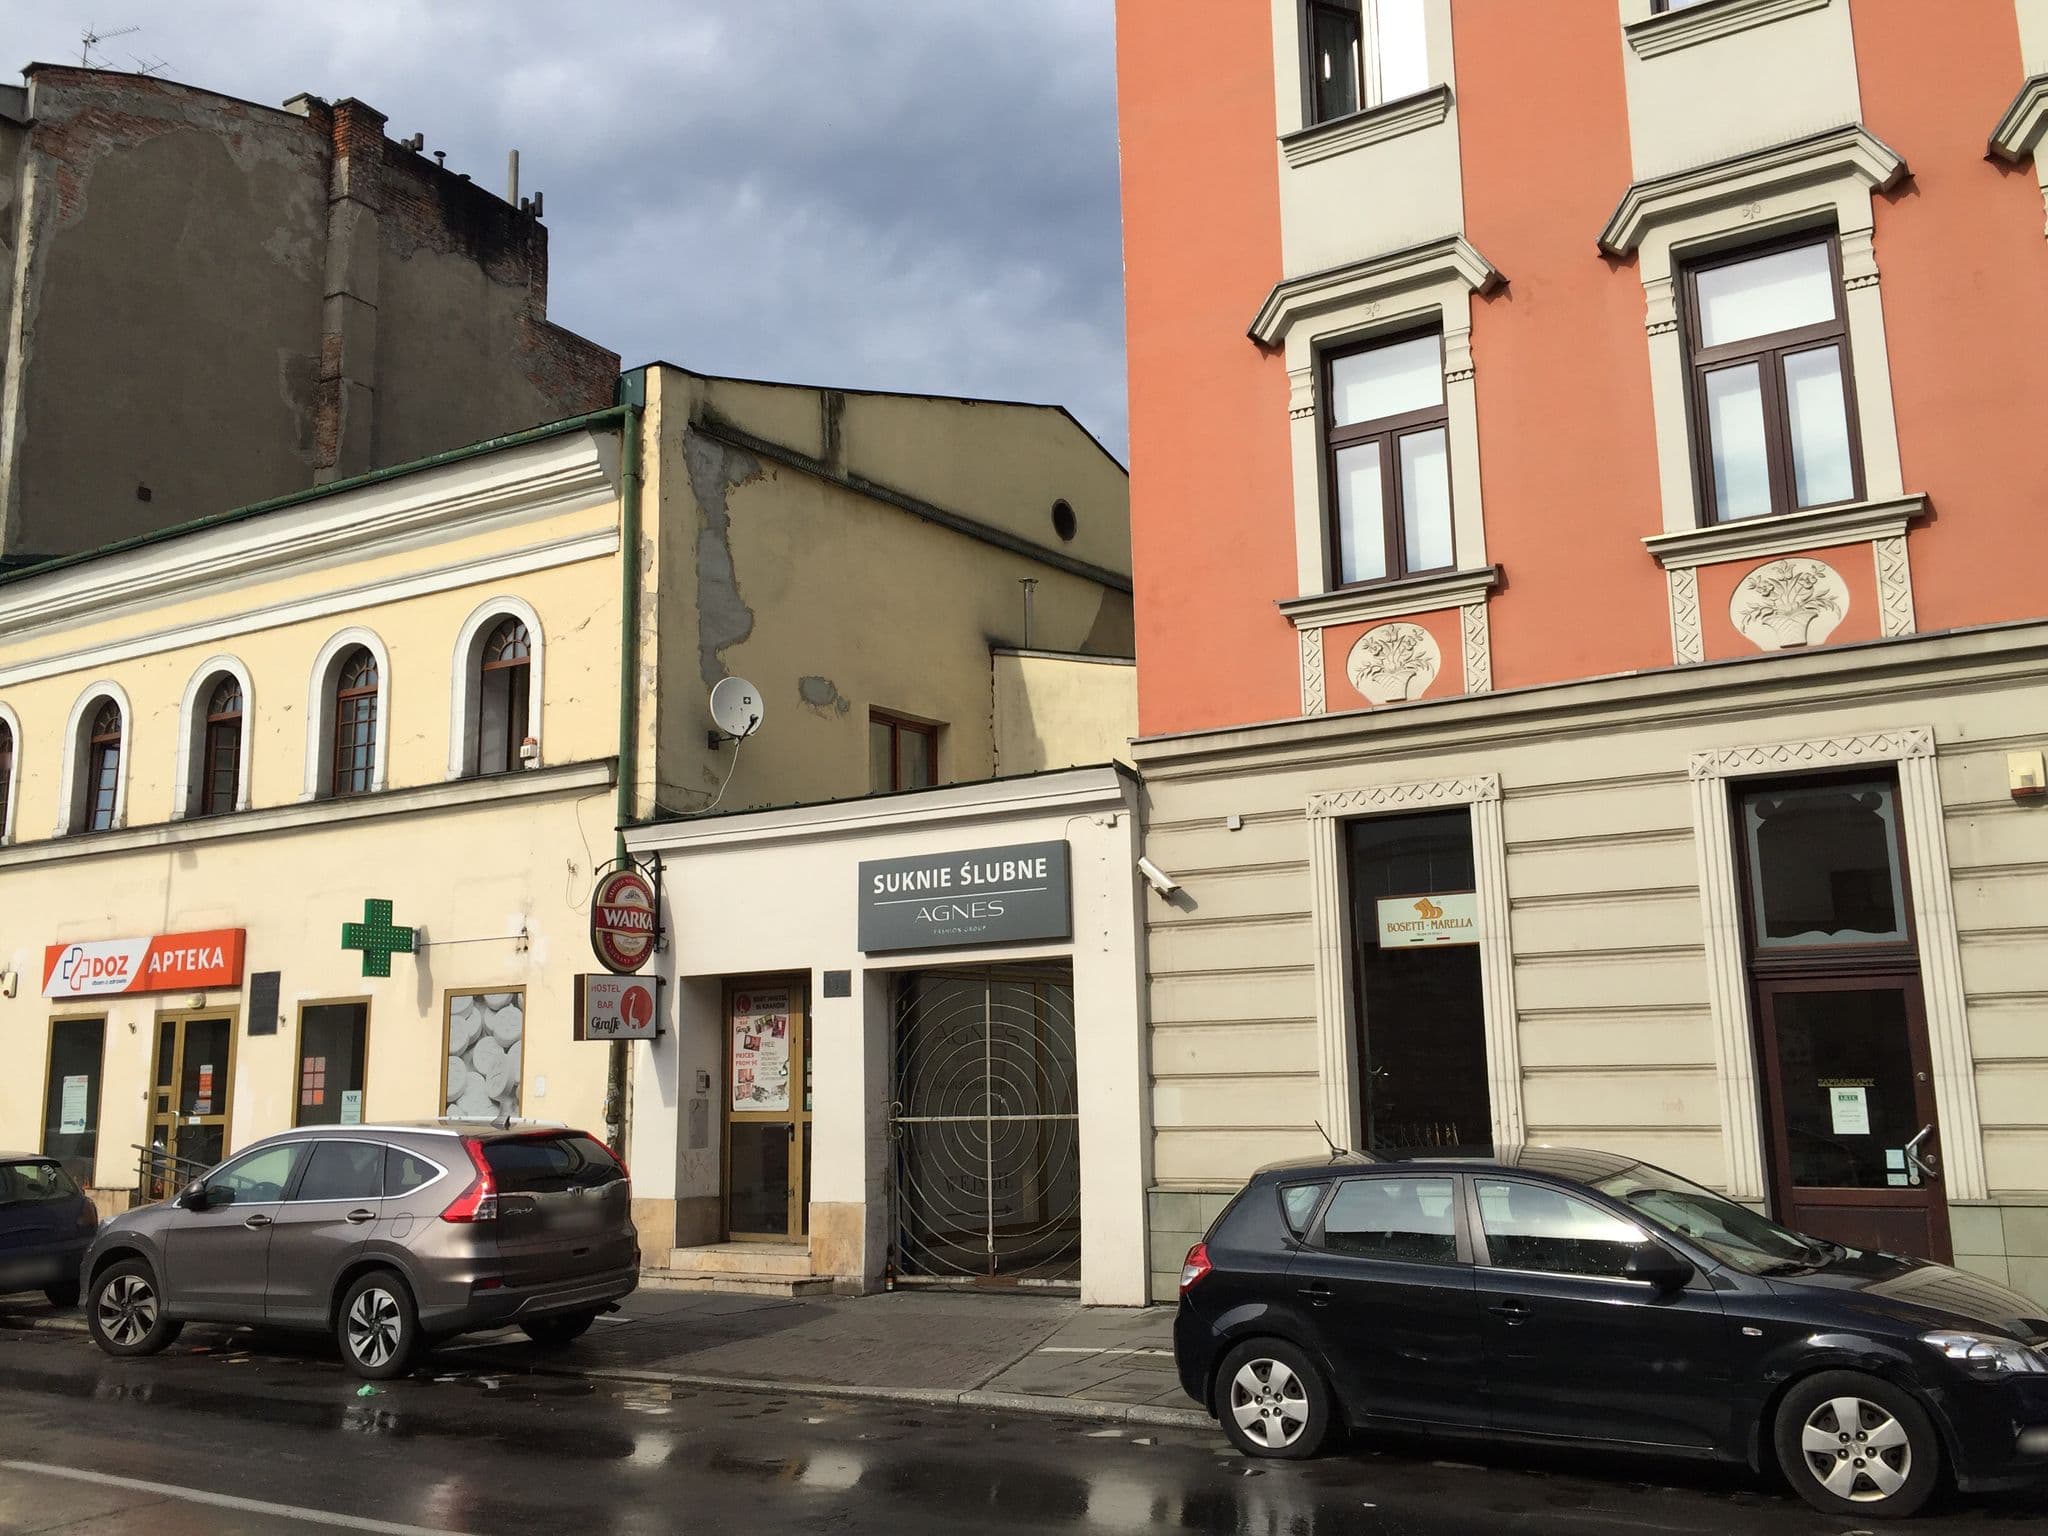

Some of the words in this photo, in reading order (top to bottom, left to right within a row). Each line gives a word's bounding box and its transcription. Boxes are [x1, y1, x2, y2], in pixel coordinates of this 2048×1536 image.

[873, 867, 952, 894] SUKNIE
[960, 857, 1048, 886] ŚLUBNE
[603, 907, 653, 931] WARKA
[914, 899, 1005, 923] AGNES
[1431, 917, 1473, 929] MARELLA
[92, 955, 129, 978] DOZ
[148, 946, 225, 974] APTEKA
[591, 983, 621, 994] HOSTEL
[597, 1000, 614, 1009] BAR
[591, 1016, 621, 1035] Giraffe
